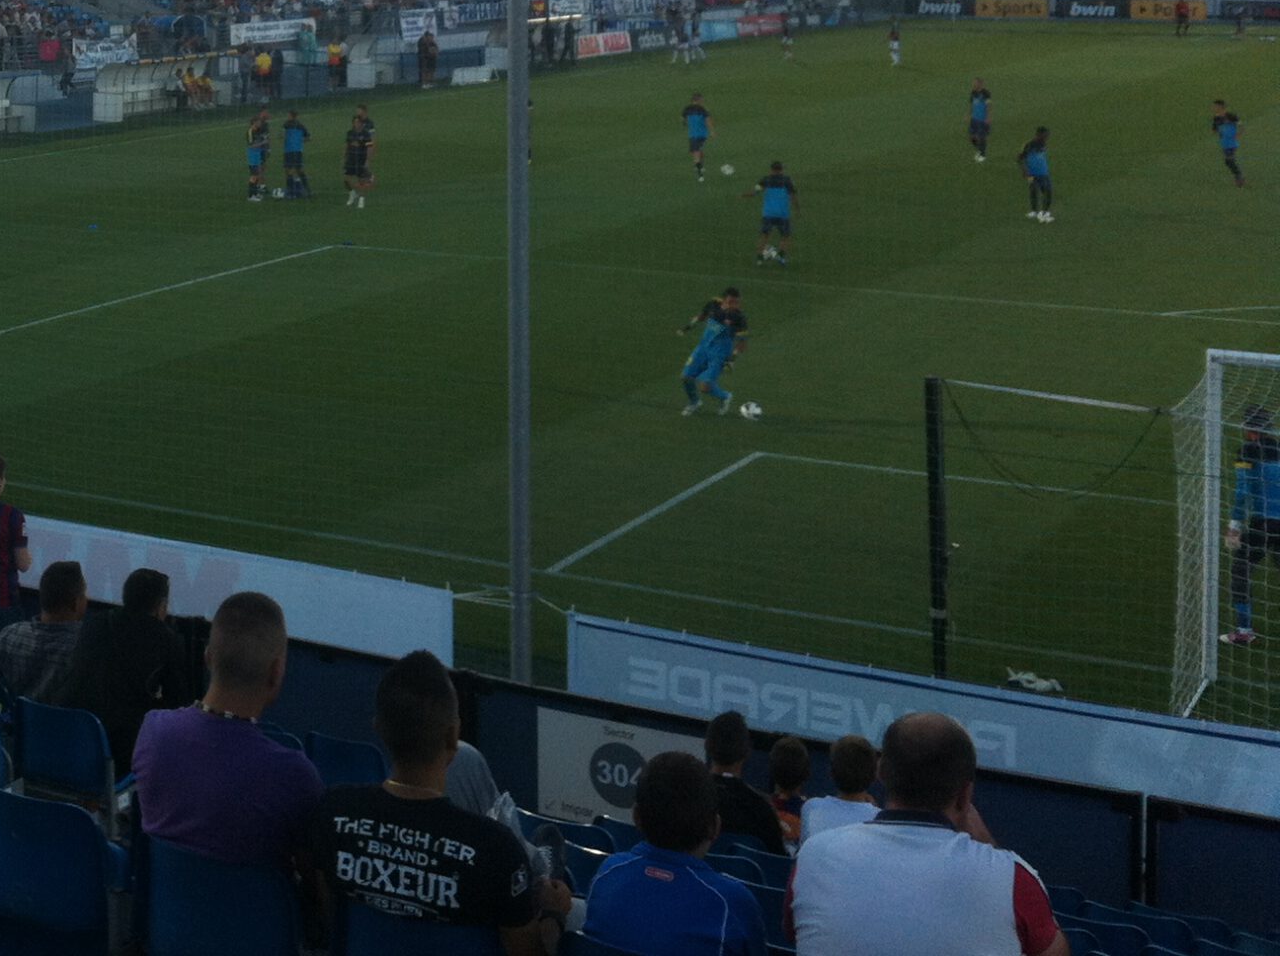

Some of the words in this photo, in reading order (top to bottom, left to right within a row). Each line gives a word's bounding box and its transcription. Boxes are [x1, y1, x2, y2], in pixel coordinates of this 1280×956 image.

[918, 0, 961, 14] bwin
[993, 0, 1041, 16] Sports
[1069, 1, 1116, 16] bwin
[1152, 3, 1200, 16] Por
[604, 725, 635, 741] Sector
[334, 815, 376, 837] THE
[367, 839, 430, 867] BRAND
[335, 850, 461, 909] BOXEUR
